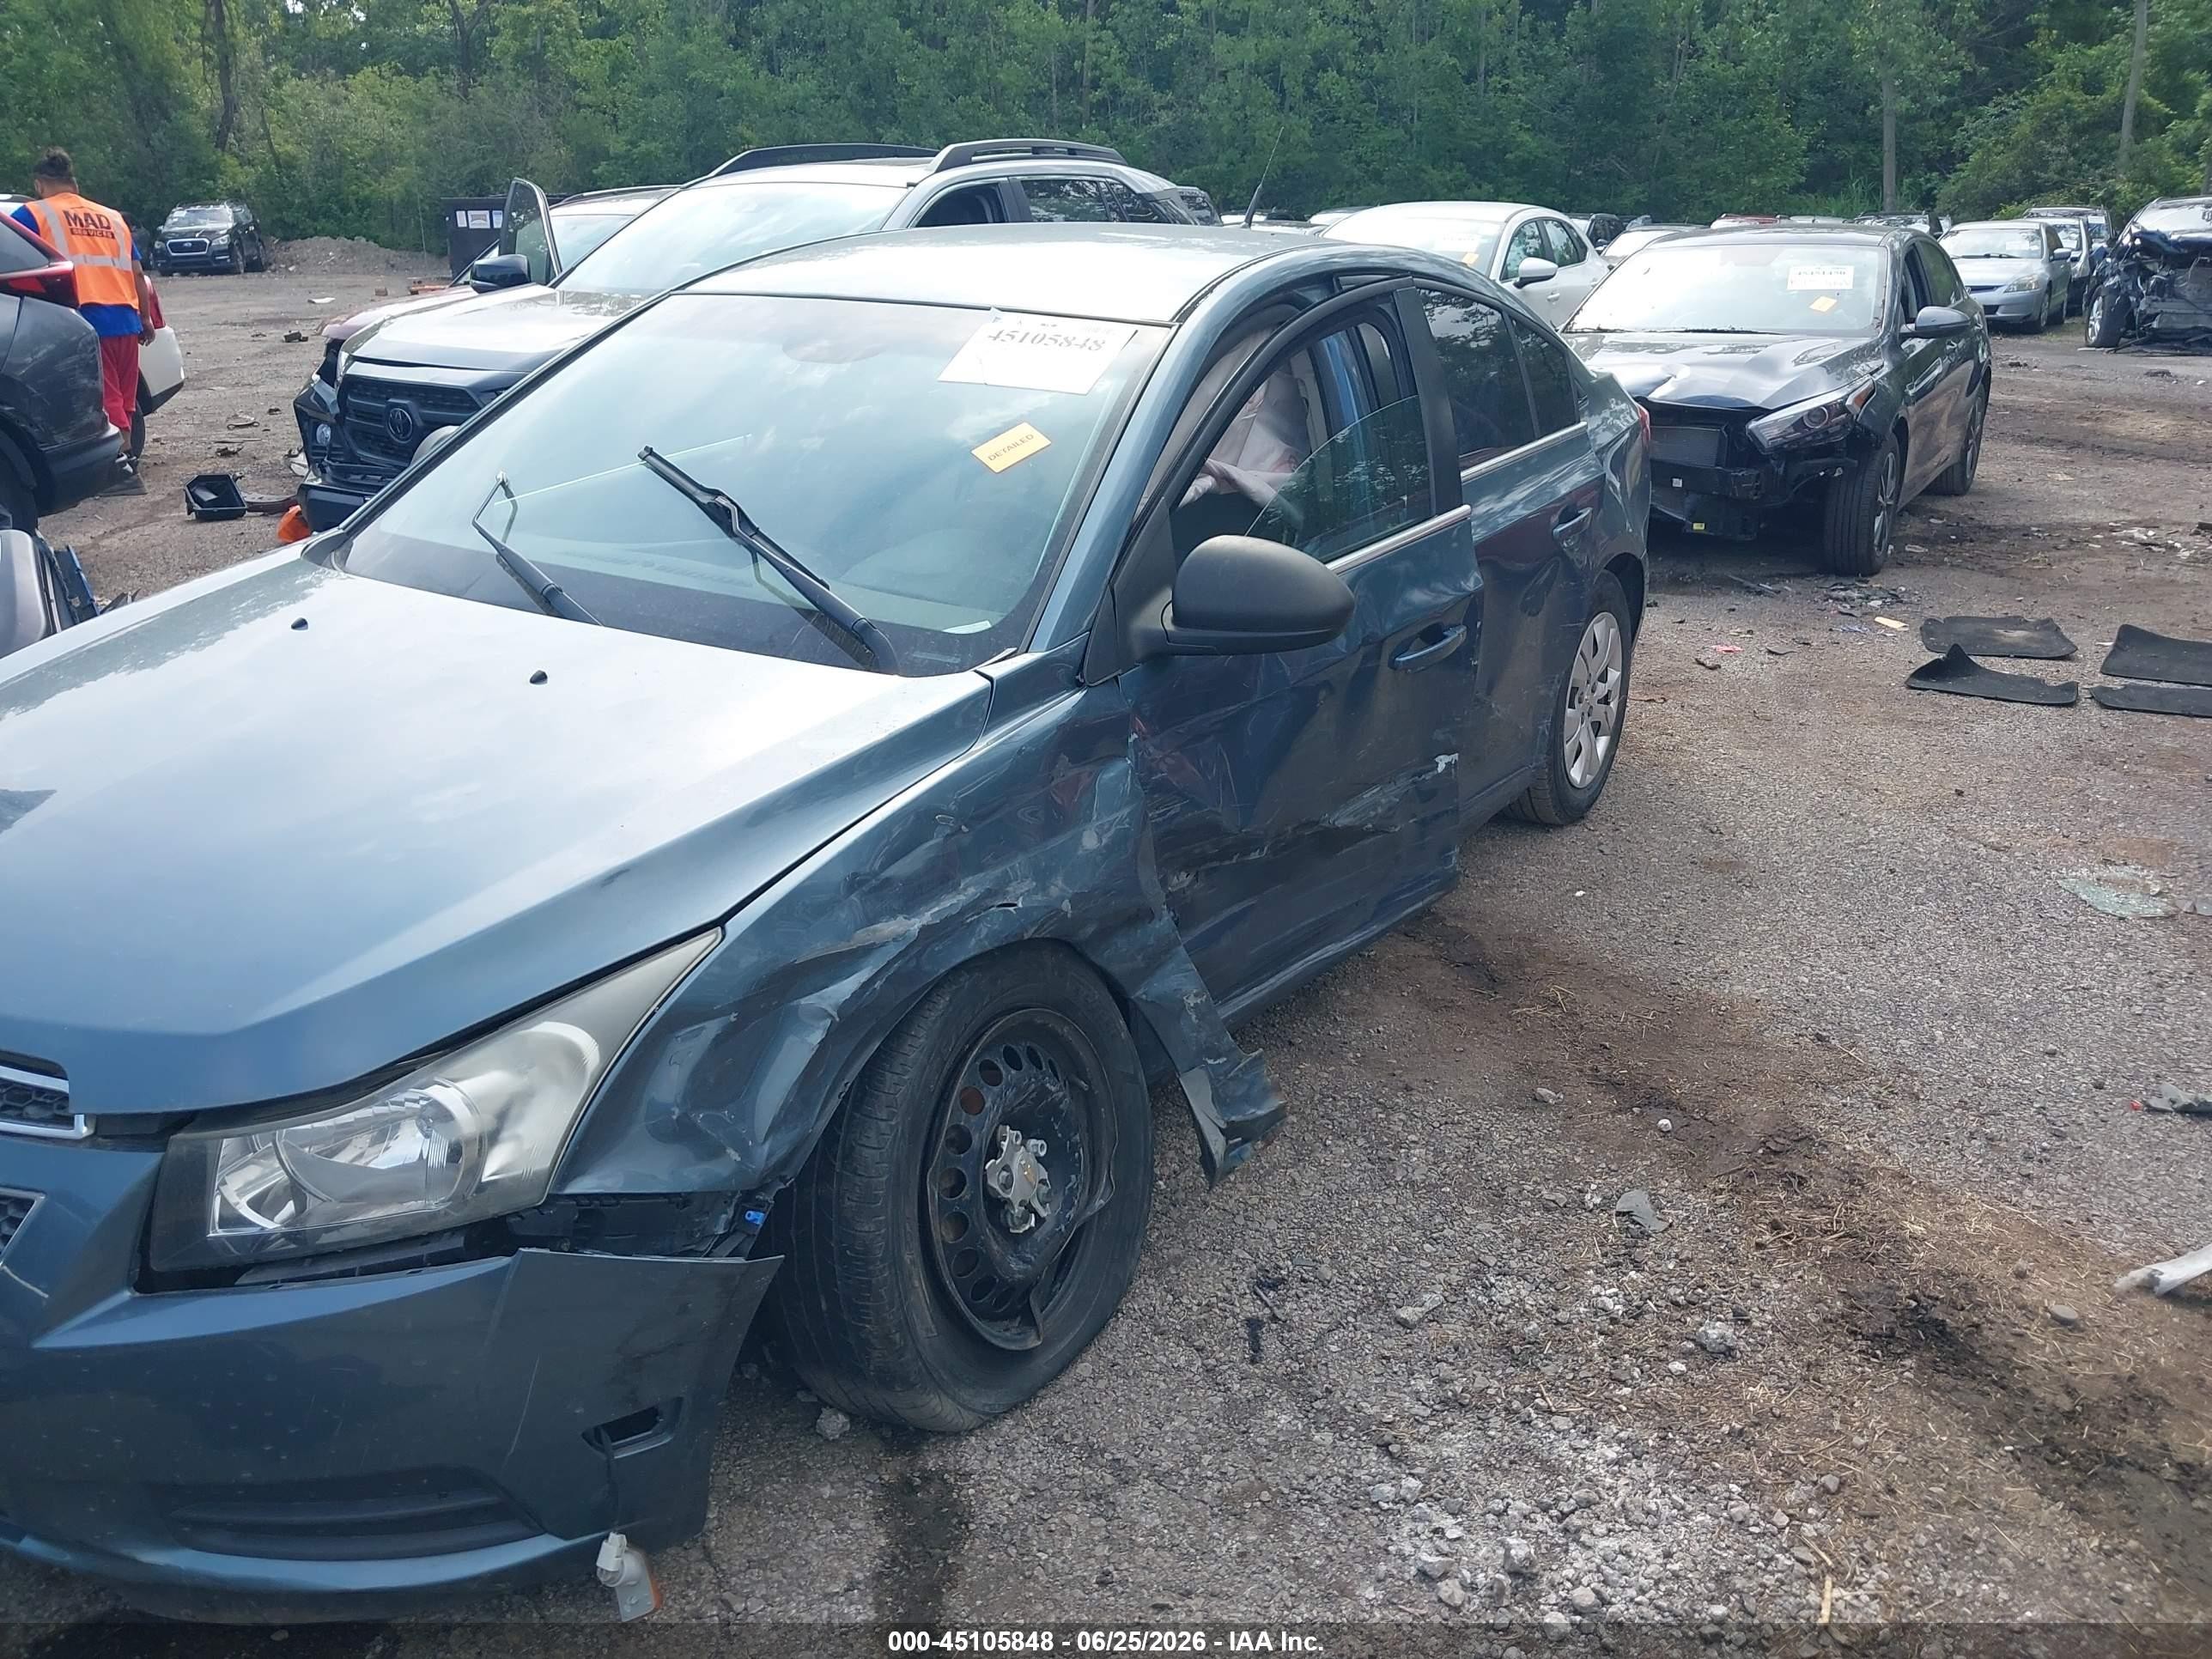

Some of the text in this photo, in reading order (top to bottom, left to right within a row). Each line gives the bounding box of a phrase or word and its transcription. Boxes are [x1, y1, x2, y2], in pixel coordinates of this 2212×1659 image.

[63, 210, 112, 230] MAD
[988, 329, 1106, 350] 45105848
[988, 434, 1034, 461] DETAILED
